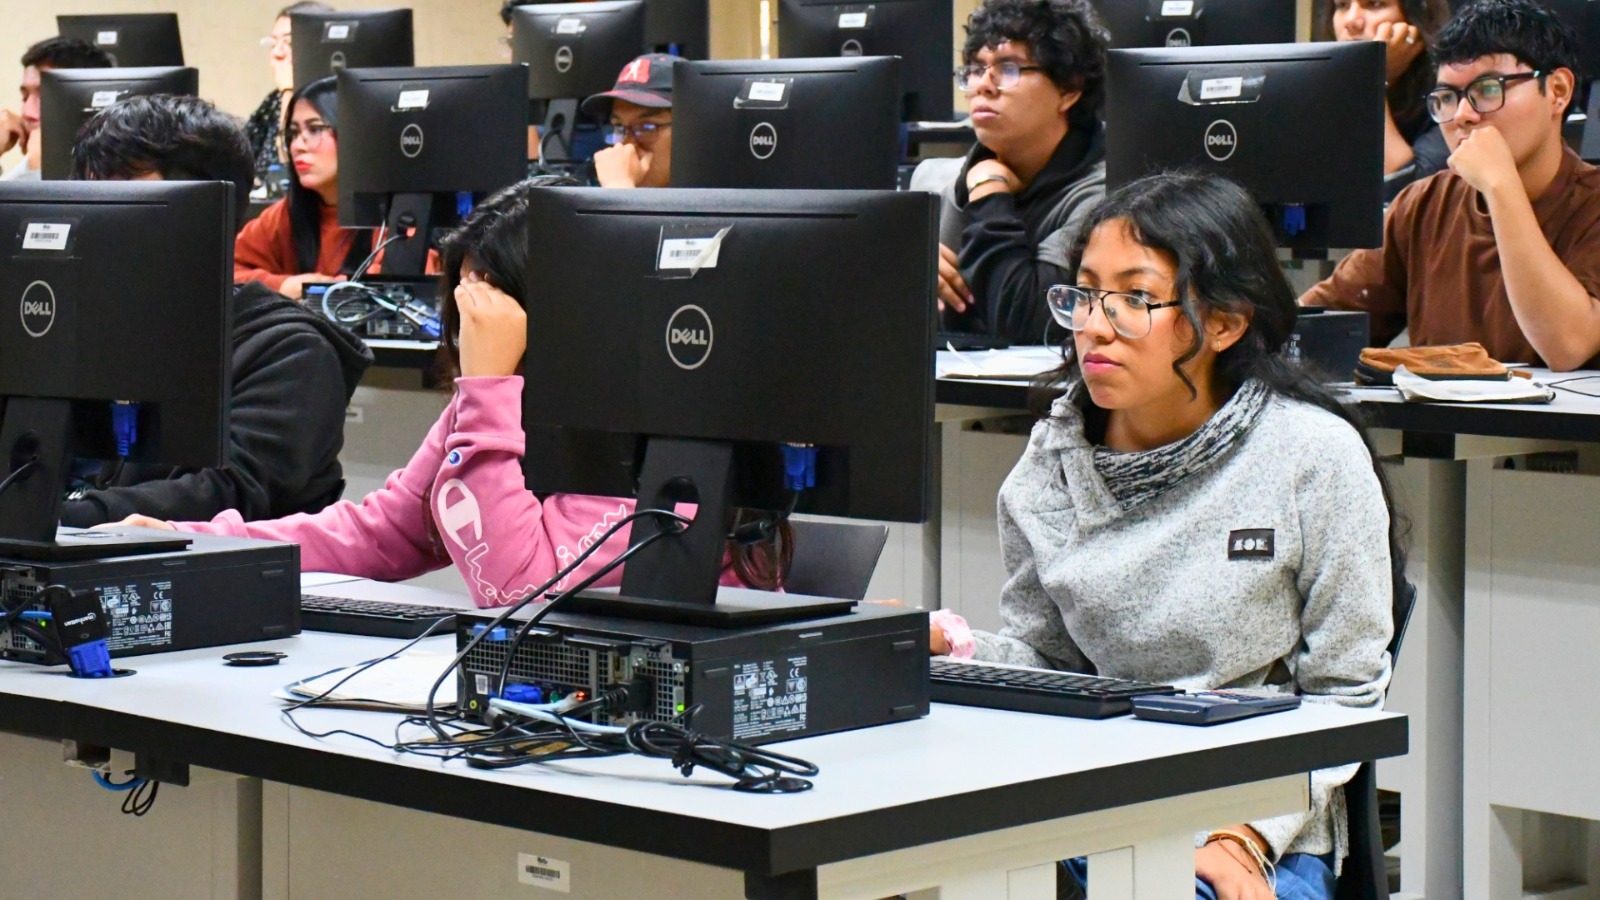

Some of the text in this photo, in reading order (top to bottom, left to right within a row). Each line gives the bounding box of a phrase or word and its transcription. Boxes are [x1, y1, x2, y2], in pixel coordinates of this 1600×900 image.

[403, 135, 421, 146] DELL
[752, 135, 774, 146] DELL
[1207, 135, 1233, 146] DELL
[24, 301, 52, 316] DELL
[671, 328, 708, 345] DELL
